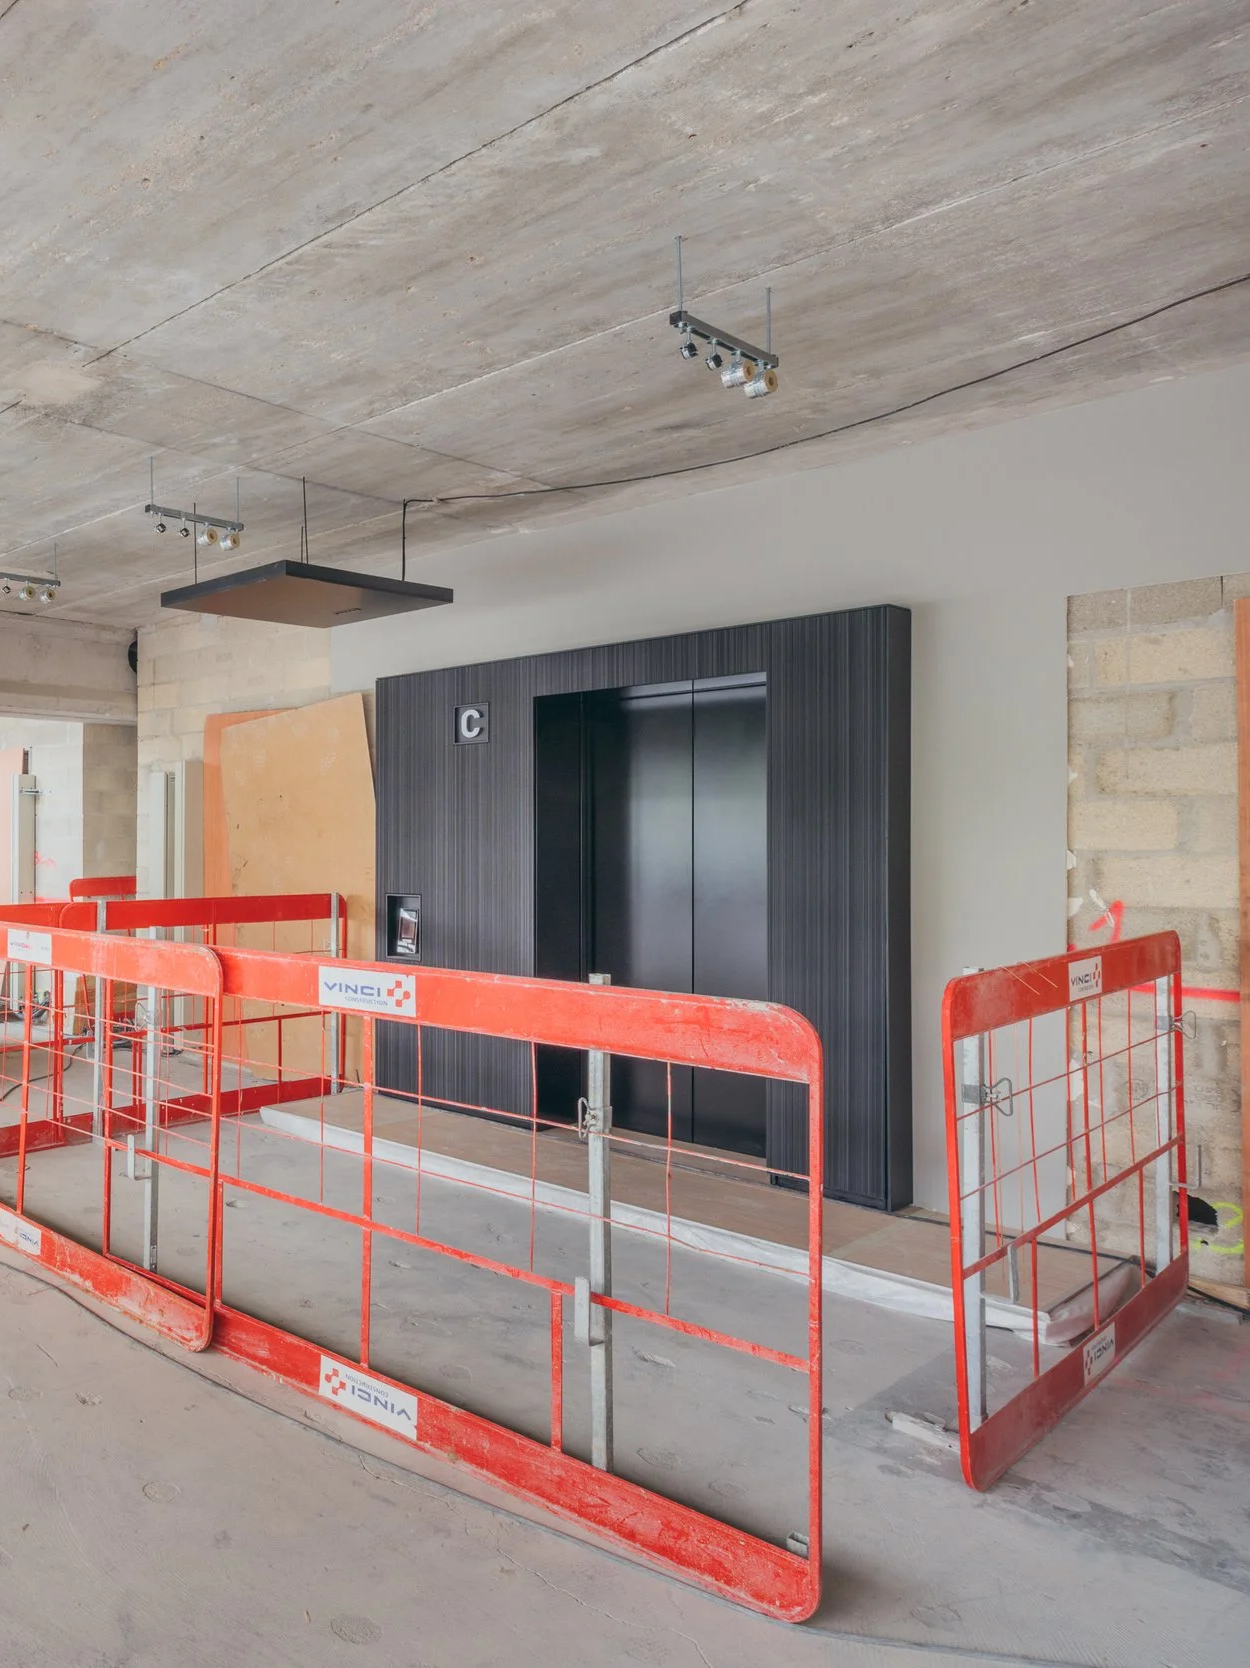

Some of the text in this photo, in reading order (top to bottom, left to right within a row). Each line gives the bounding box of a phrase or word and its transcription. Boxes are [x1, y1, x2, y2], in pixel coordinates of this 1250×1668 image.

[460, 708, 480, 738] C
[323, 980, 381, 998] VINCI
[1070, 972, 1092, 987] VINCI
[344, 995, 389, 1007] CONSTRUCTION
[345, 1373, 389, 1398] CONSTRUCTION
[351, 1385, 412, 1421] VINCI
